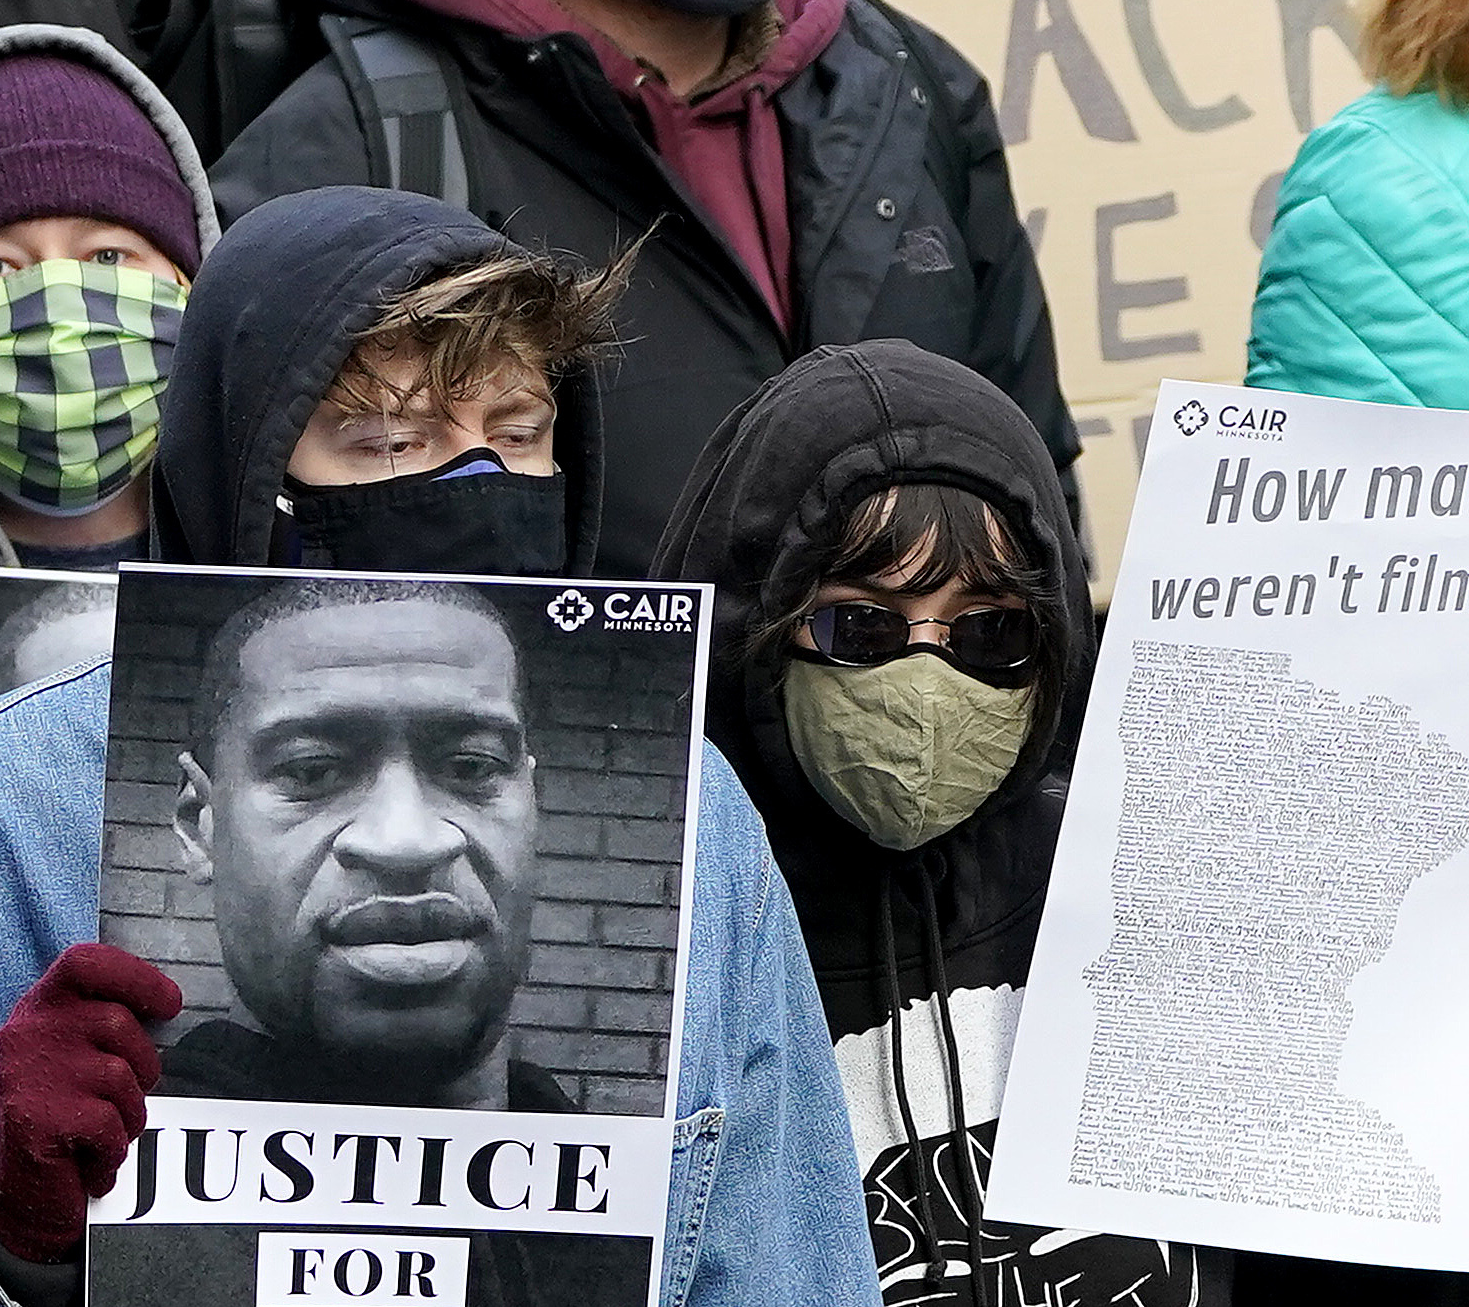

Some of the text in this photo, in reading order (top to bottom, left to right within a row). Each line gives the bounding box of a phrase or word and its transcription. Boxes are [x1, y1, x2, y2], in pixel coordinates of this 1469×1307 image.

[1215, 428, 1285, 443] MINNESOTA
[1218, 404, 1288, 432] CAIR
[1204, 456, 1347, 525] How
[603, 592, 694, 622] CAIR
[1149, 554, 1363, 620] weren't
[603, 620, 693, 633] MINNESOTA
[125, 1126, 611, 1221] JUSTICE
[287, 1247, 438, 1298] FOR
